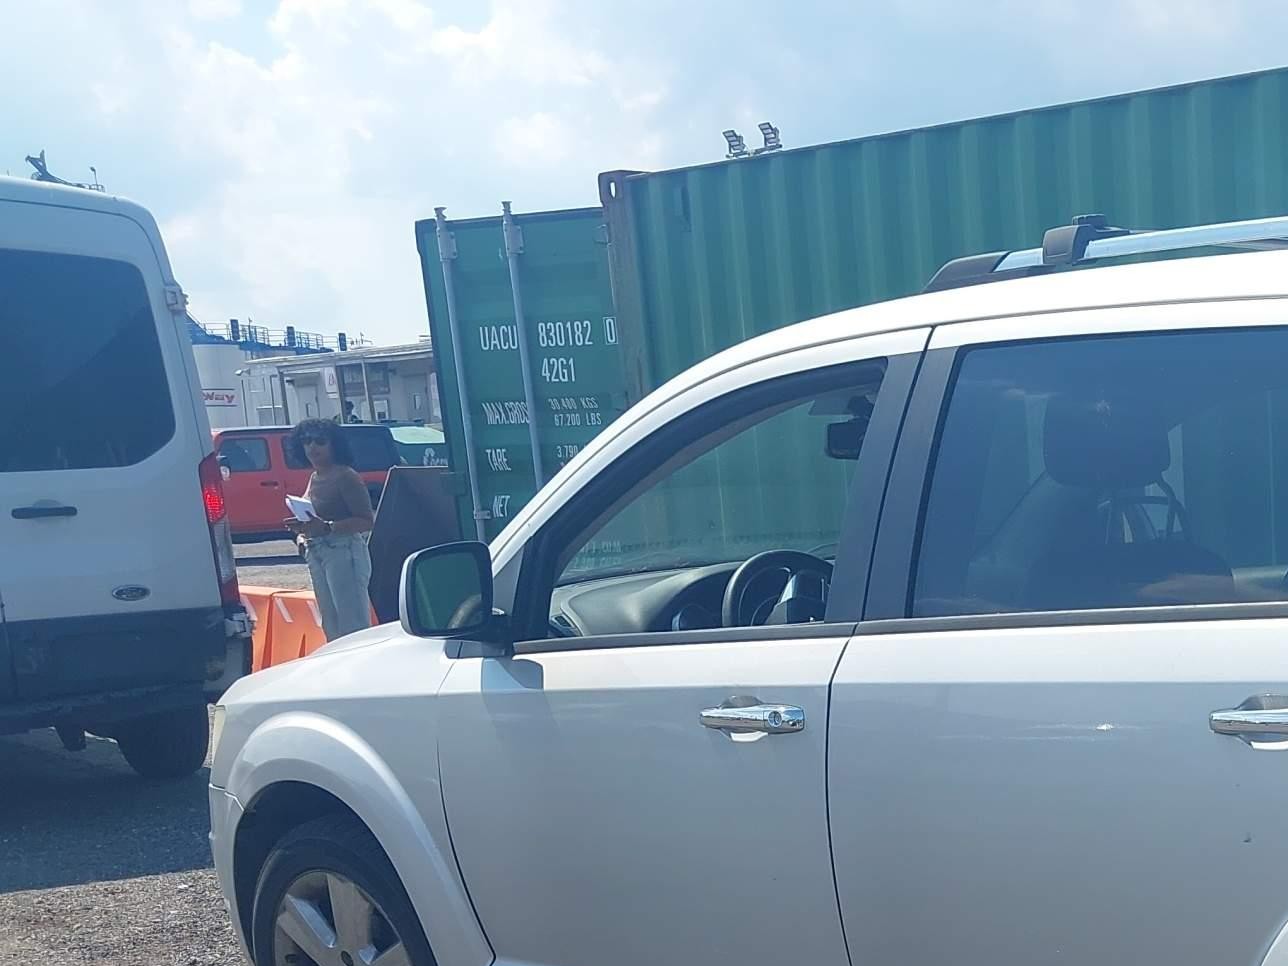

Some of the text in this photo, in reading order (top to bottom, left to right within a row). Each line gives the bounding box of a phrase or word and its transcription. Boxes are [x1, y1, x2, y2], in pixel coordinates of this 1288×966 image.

[479, 318, 616, 350] UACU 830182 0
[541, 357, 576, 382] 42G1
[481, 401, 530, 425] MAX.GROS
[580, 396, 599, 409] KGS
[554, 412, 602, 426] 67.200 LBS
[485, 448, 511, 471] TARE
[492, 495, 511, 518] NET
